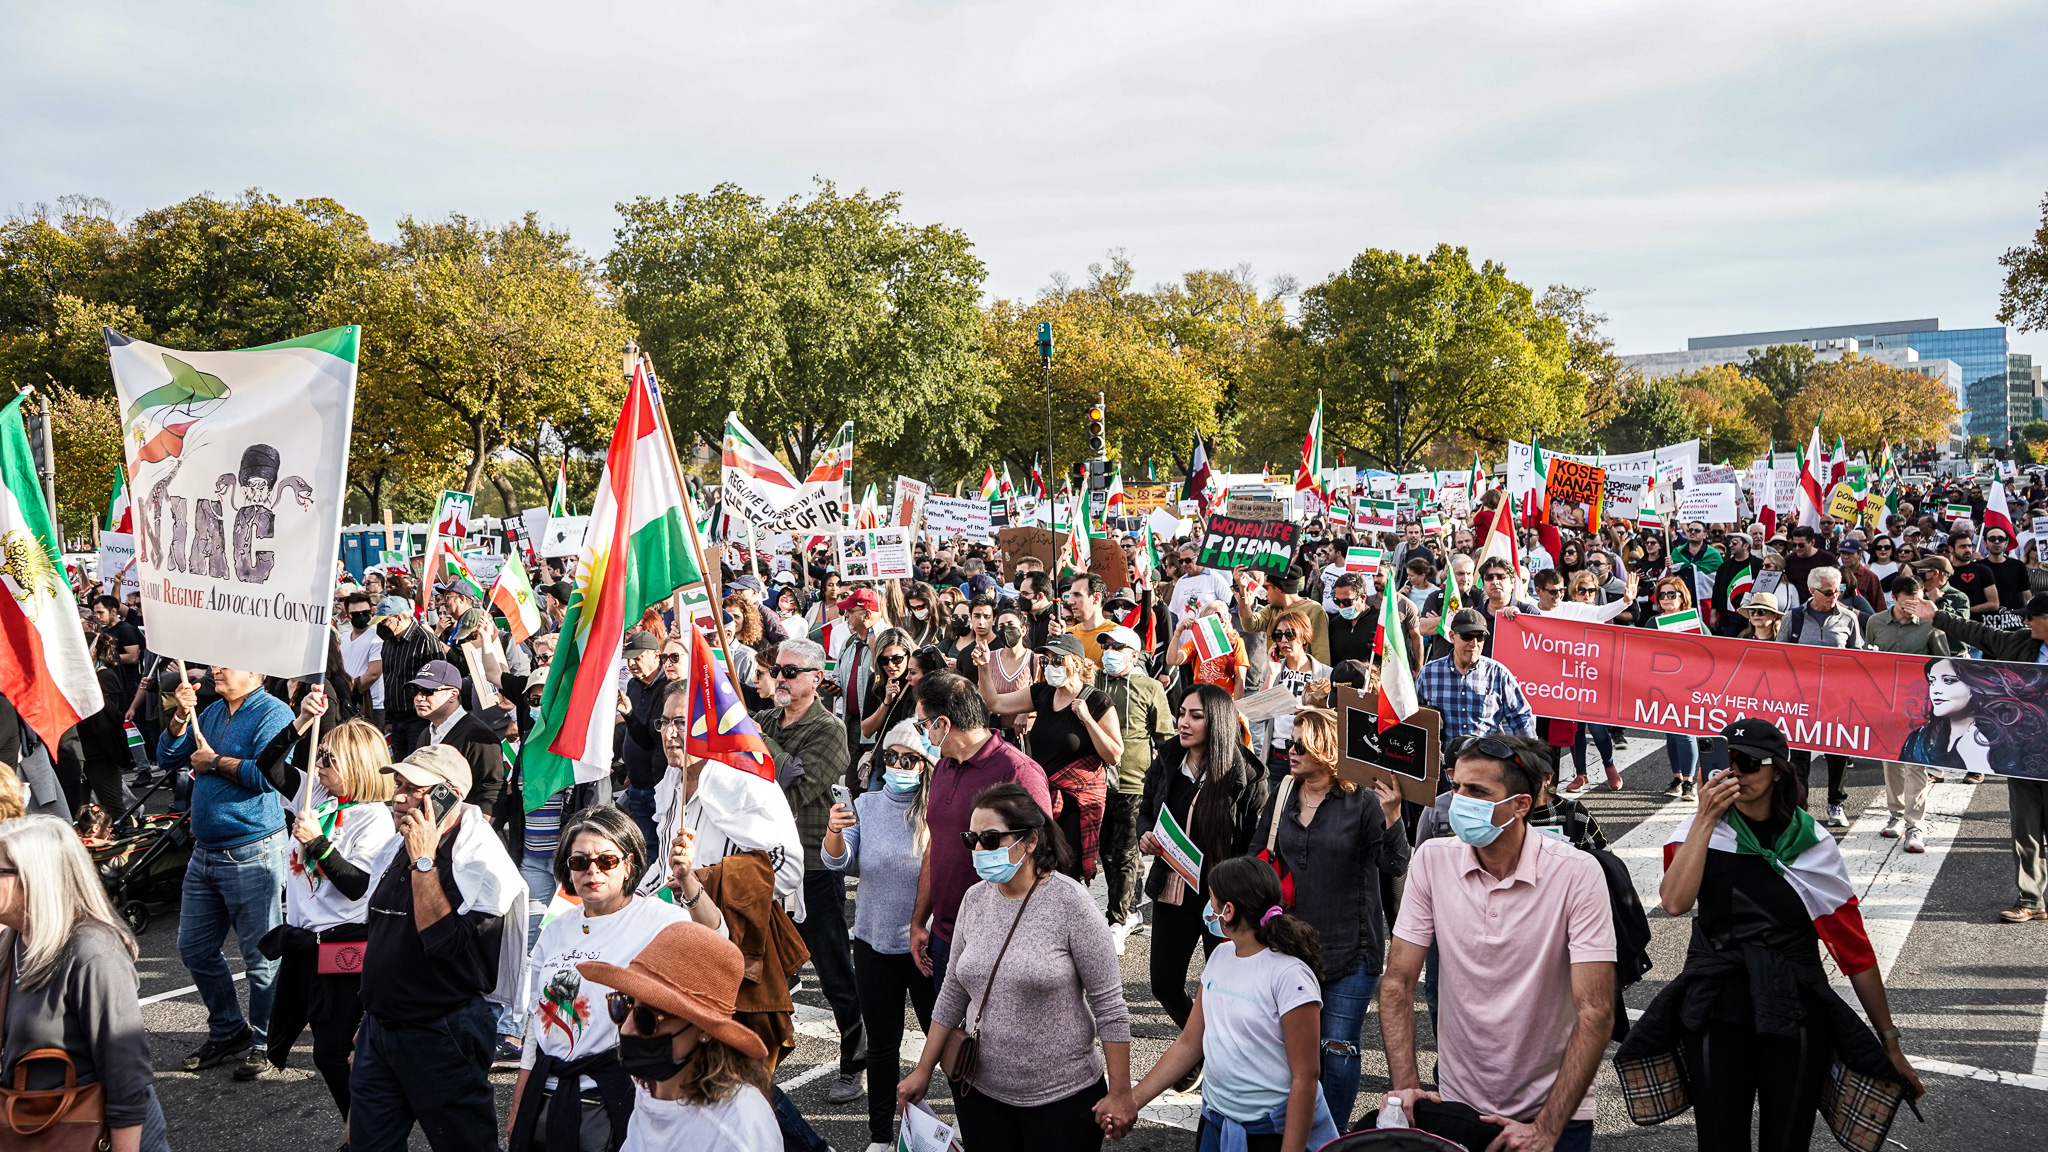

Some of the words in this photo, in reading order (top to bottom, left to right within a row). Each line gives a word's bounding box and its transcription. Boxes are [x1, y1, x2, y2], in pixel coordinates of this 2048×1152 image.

[1556, 459, 1599, 481] KOSE
[727, 469, 764, 507] REGIME
[901, 480, 921, 491] WOMAN
[1552, 473, 1602, 495] NANAT
[795, 484, 818, 529] OF
[950, 500, 971, 509] Already
[971, 503, 987, 511] Dead
[1545, 484, 1599, 507] KHAMENEI
[928, 510, 945, 518] When
[951, 514, 968, 523] Keep
[967, 513, 988, 521] Silence
[1835, 502, 1875, 523] DICTAOR
[945, 525, 967, 533] Murder
[966, 531, 987, 539] Innocent
[1211, 516, 1263, 539] WOMEN
[1262, 521, 1294, 542] LIFE
[1200, 533, 1292, 573] FREEDOM
[104, 576, 140, 588] FREDO
[163, 577, 205, 609] REGIME
[205, 584, 272, 618] ADVOCACY
[273, 592, 328, 626] COUNCIL
[1521, 631, 1600, 658] Woman
[1561, 658, 1599, 680] Life
[1513, 676, 1598, 704] reedom
[1691, 691, 1722, 707] SAY
[1725, 694, 1759, 711] HER
[1762, 698, 1810, 718] NAME
[1634, 698, 1751, 734] MAHSA
[1773, 715, 1870, 752] AMINI
[1389, 737, 1401, 747] Life
